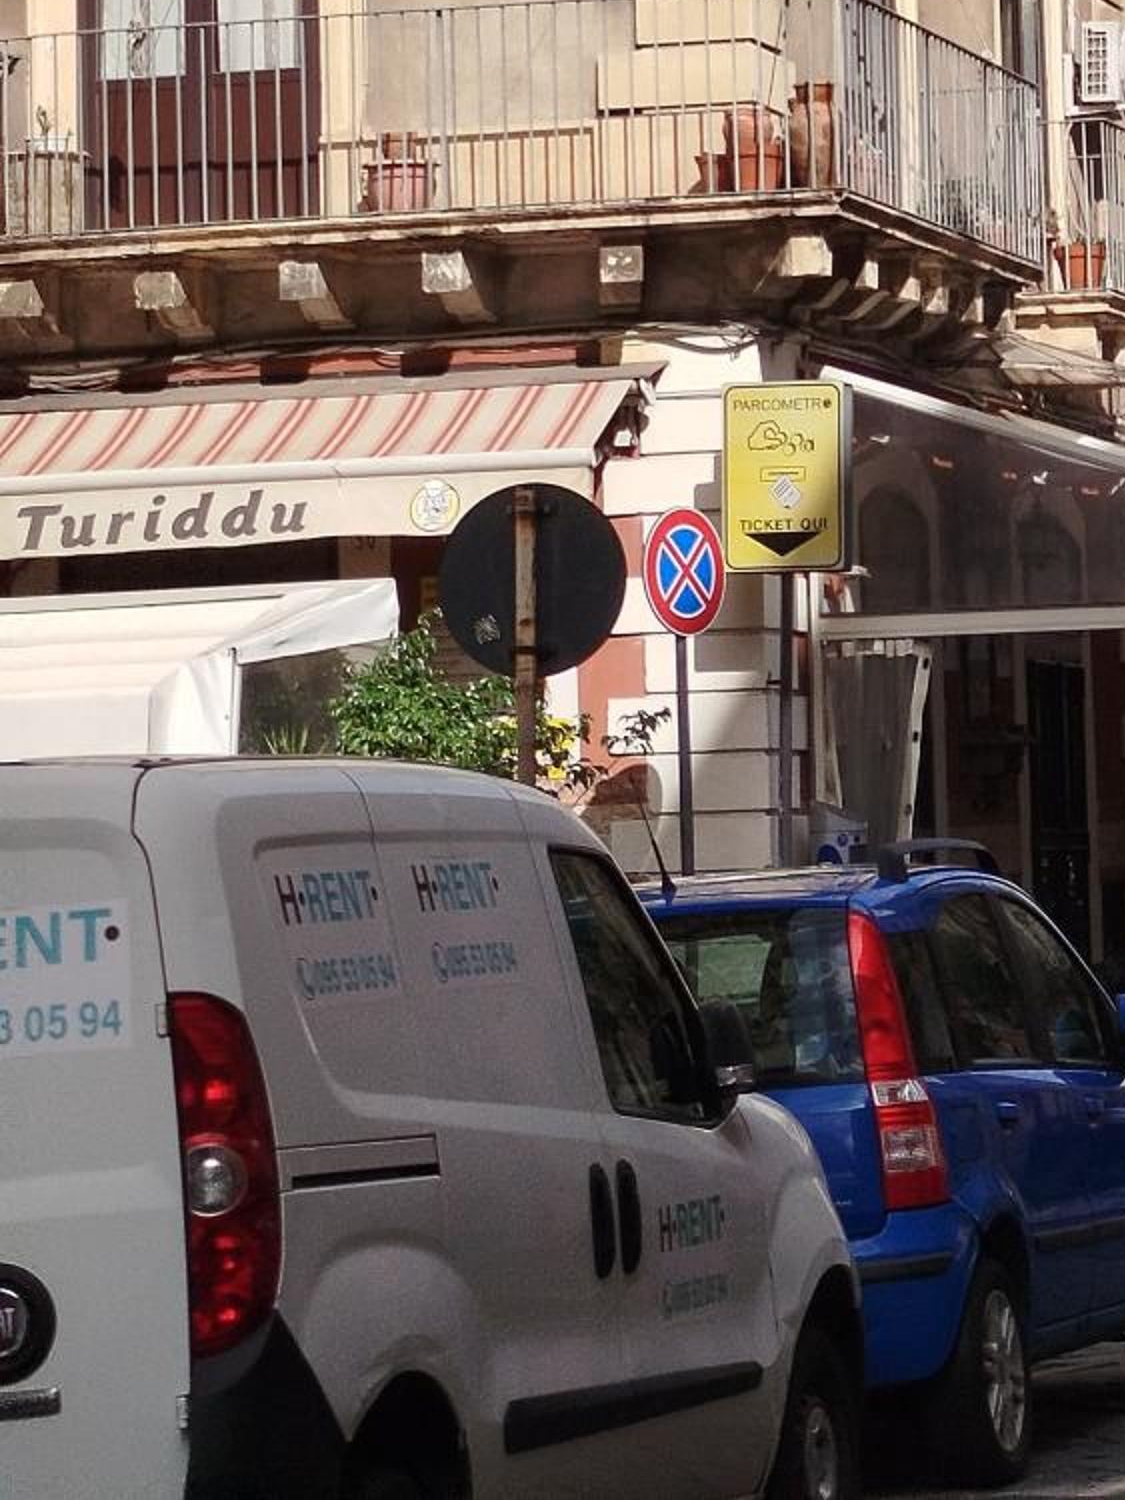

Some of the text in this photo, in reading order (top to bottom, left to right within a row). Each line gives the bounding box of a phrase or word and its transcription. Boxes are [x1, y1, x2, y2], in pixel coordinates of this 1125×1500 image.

[17, 489, 308, 551] Turiddu
[740, 517, 829, 531] TICKET QUI
[24, 1004, 68, 1041] 05
[79, 1000, 122, 1037] 94
